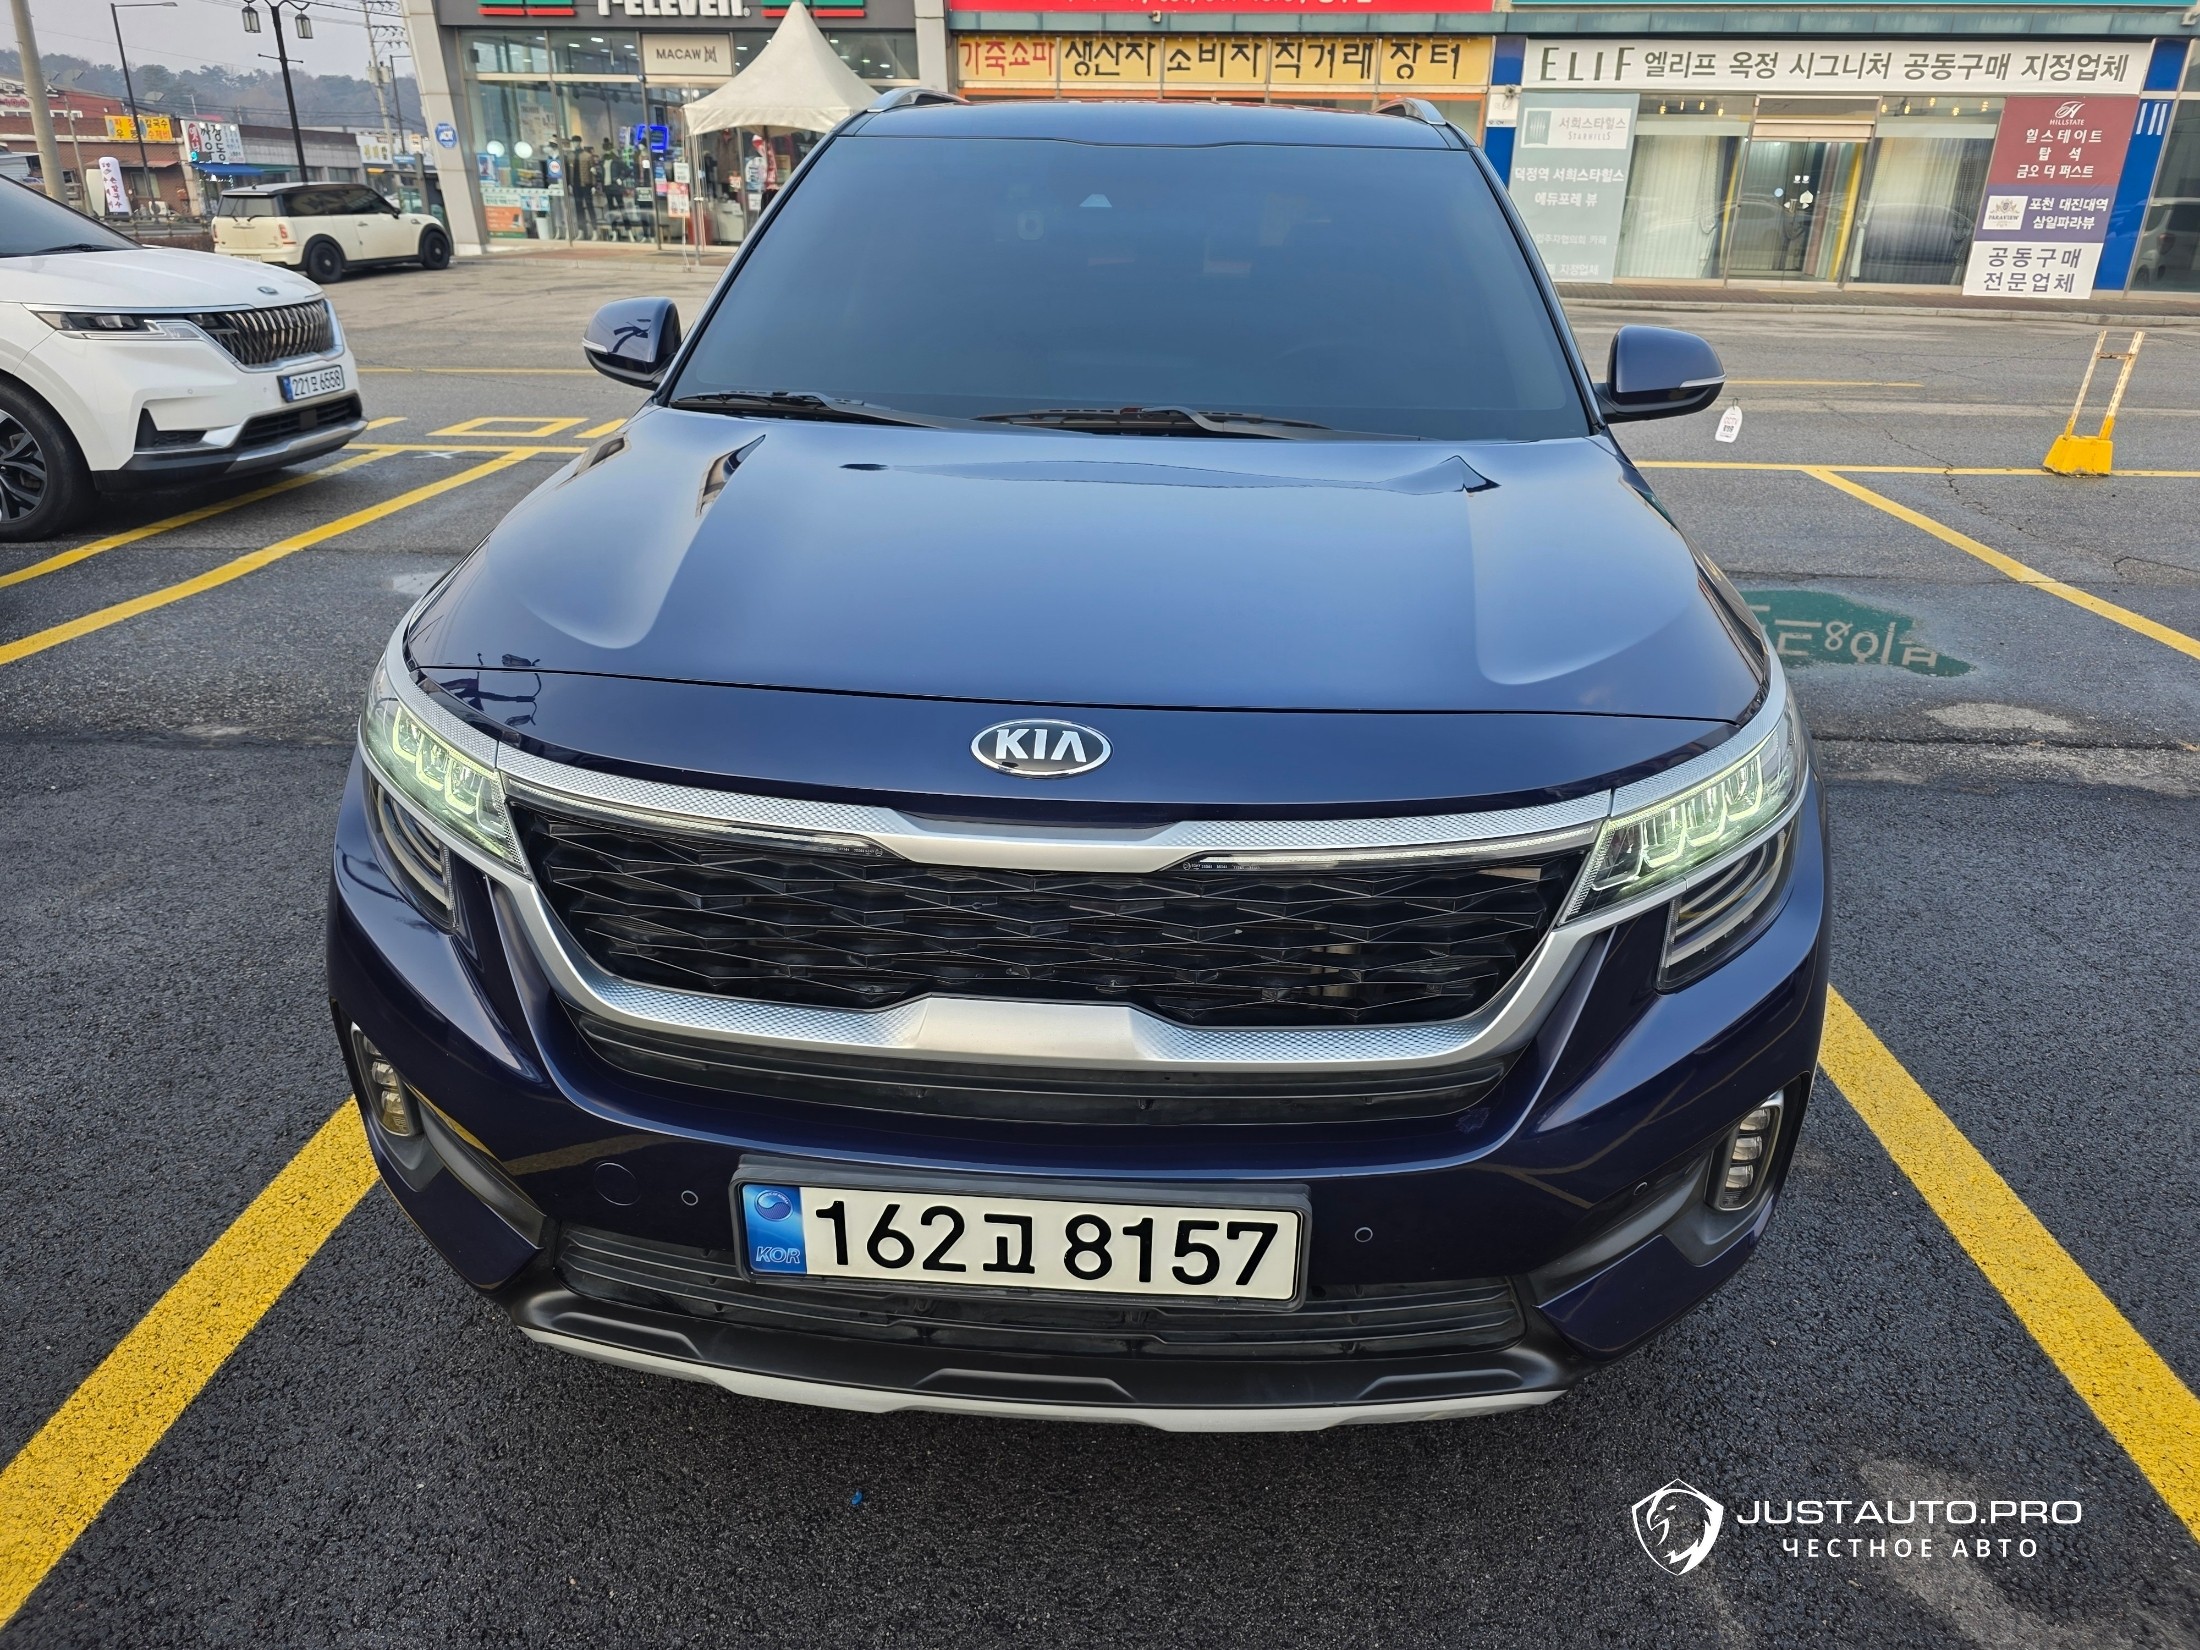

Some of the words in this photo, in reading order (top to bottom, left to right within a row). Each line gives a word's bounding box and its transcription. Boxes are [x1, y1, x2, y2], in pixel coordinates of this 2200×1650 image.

[656, 48, 701, 60] MACAW
[960, 41, 1055, 77] 가죽쇼파
[1065, 39, 1156, 77] 생산자
[1167, 42, 1261, 78] 소비자
[1274, 42, 1374, 80] 직거래
[1389, 42, 1462, 80] 장터
[1540, 47, 1635, 81] ELIF
[1645, 51, 1717, 79] 엘리프
[1729, 51, 1779, 80] 옥정
[1789, 52, 1892, 80] 시그니처
[1904, 53, 2012, 81] 공동구매
[2021, 53, 2130, 82] 지정업체
[1559, 116, 1626, 130] 서희스타힐스
[2026, 128, 2103, 144] 힐스테이트
[1515, 167, 1550, 182] 덕정역
[1553, 168, 1625, 183] 서희스타힐스
[2016, 165, 2040, 179] 금오
[2044, 165, 2055, 179] 더
[2059, 165, 2094, 179] 퍼스트
[1534, 192, 1581, 207] 에듀포레
[1585, 192, 1598, 208] 뷰
[2029, 197, 2055, 211] 포천
[2059, 197, 2109, 212] 대진대역
[2033, 215, 2095, 230] 삼일파라뷰
[1988, 247, 2083, 269] 공동구매
[1983, 271, 2076, 293] 전문업체
[319, 369, 341, 391] 6558
[995, 728, 1087, 763] KIA
[815, 1200, 1036, 1275] 162고
[1064, 1213, 1280, 1287] 8157
[756, 1246, 801, 1264] KOR
